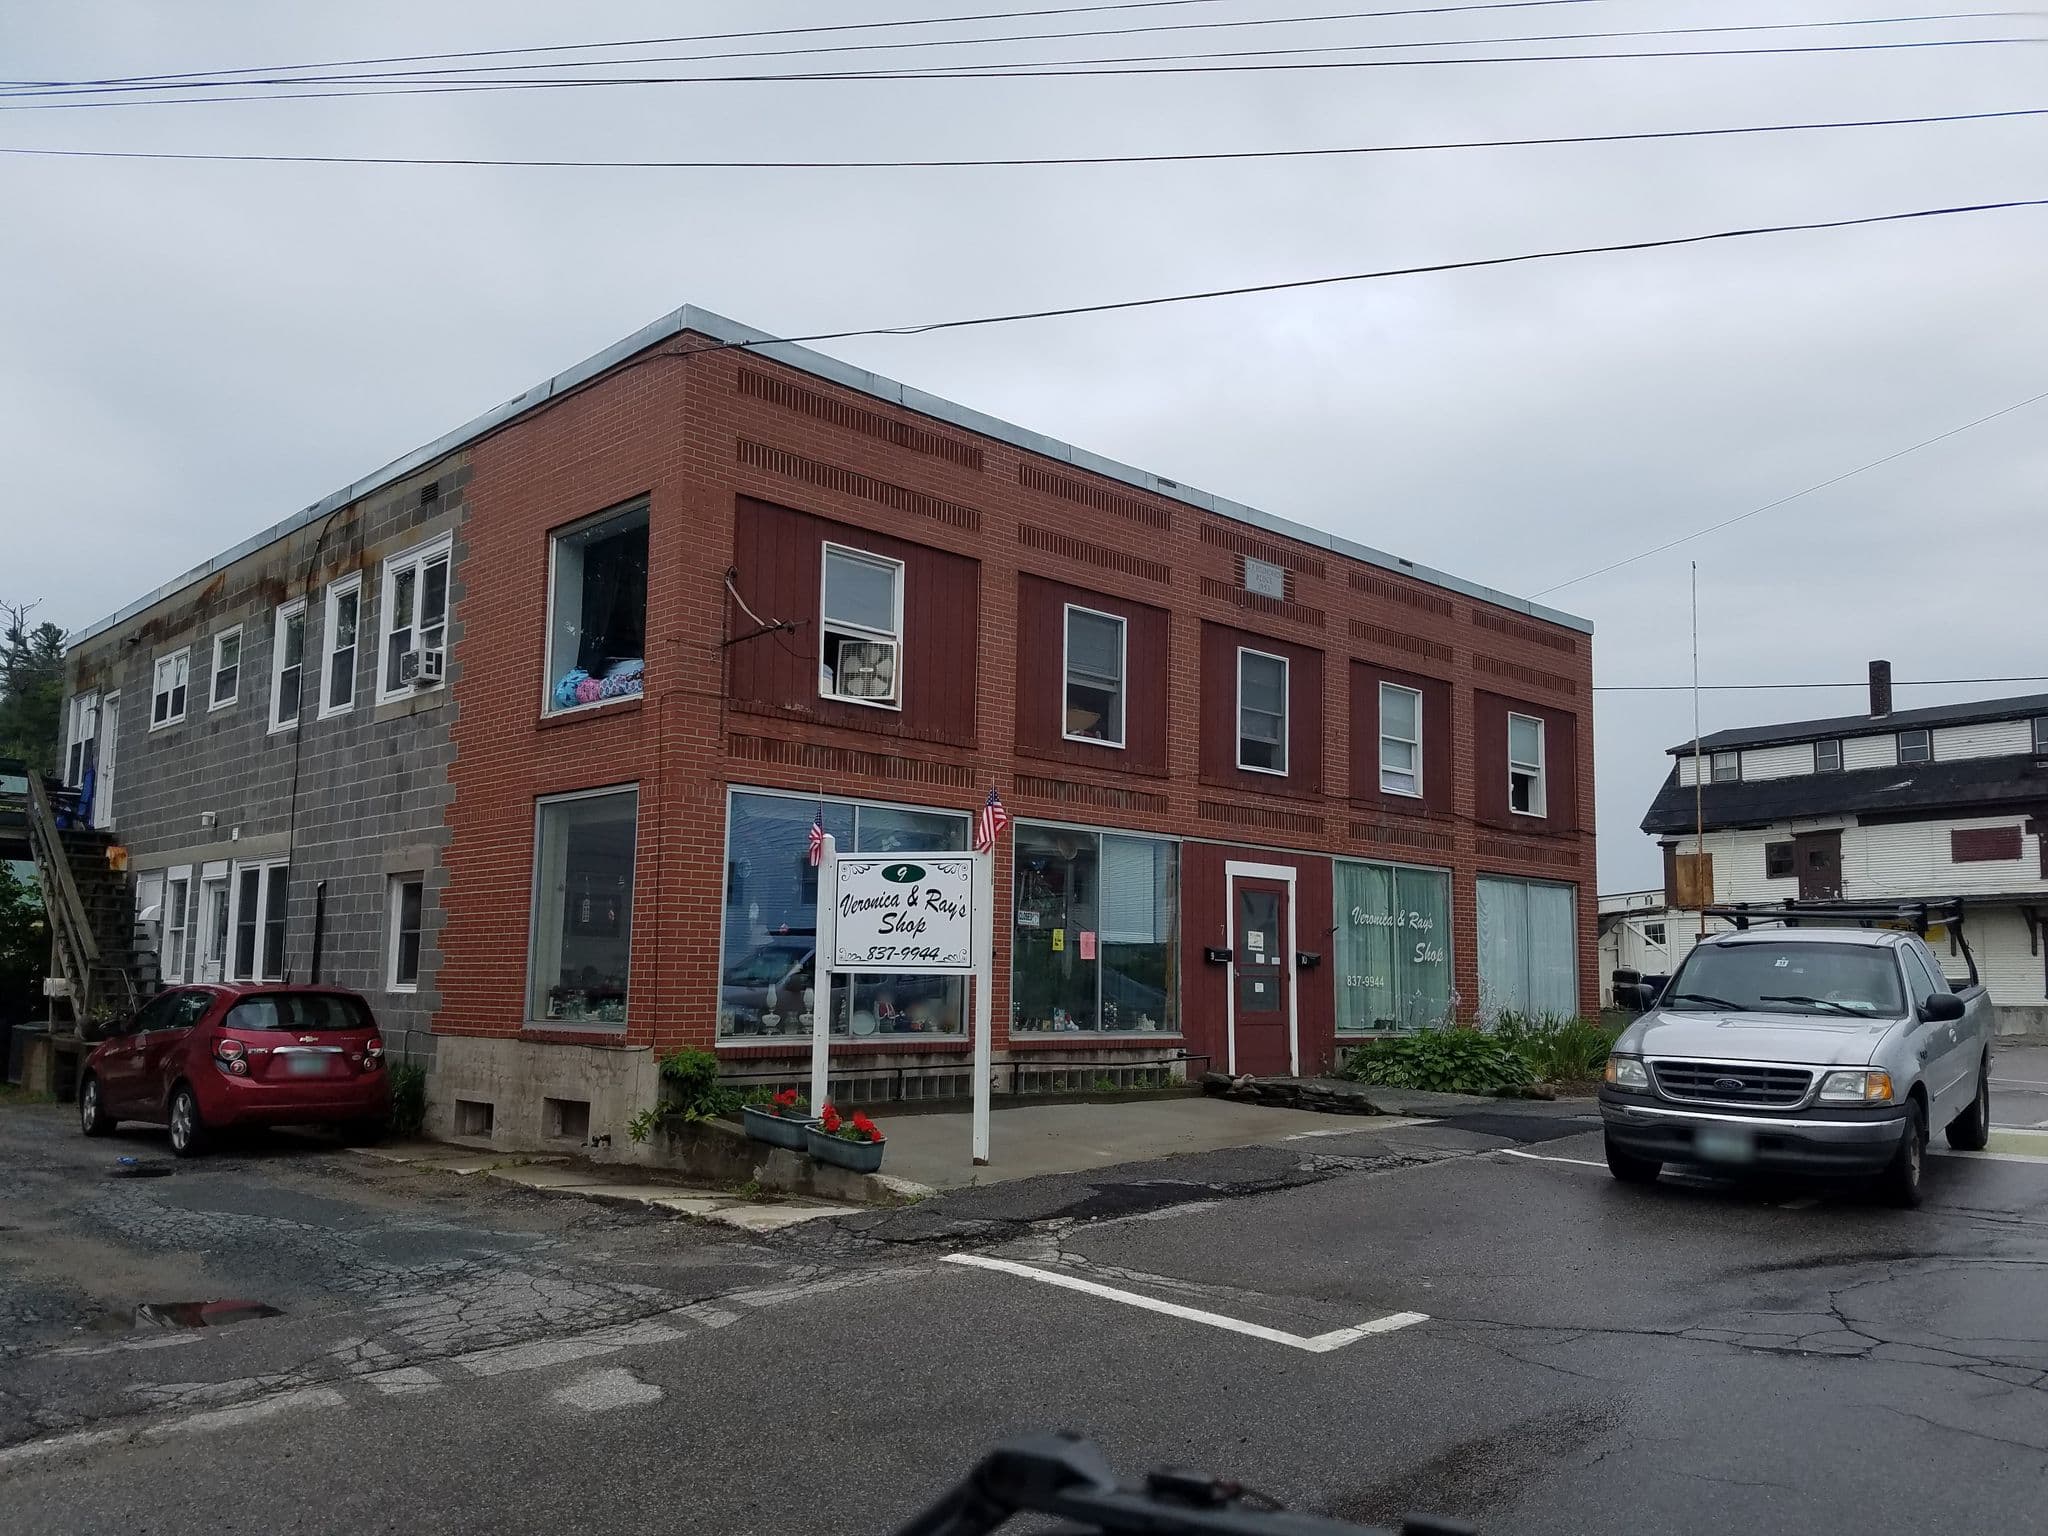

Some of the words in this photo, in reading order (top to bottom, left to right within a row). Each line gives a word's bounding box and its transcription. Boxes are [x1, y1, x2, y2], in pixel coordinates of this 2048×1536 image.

[896, 866, 908, 882] 9
[839, 891, 901, 918] Veronica
[906, 884, 919, 907] &
[924, 888, 967, 921] Ray's
[878, 910, 927, 939] Shop
[1351, 906, 1395, 927] Veronica
[1396, 909, 1405, 927] &
[1408, 911, 1434, 934] Ray's
[866, 946, 940, 961] 837-9944
[1413, 942, 1445, 968] Shop
[1346, 975, 1385, 987] 837-9944
